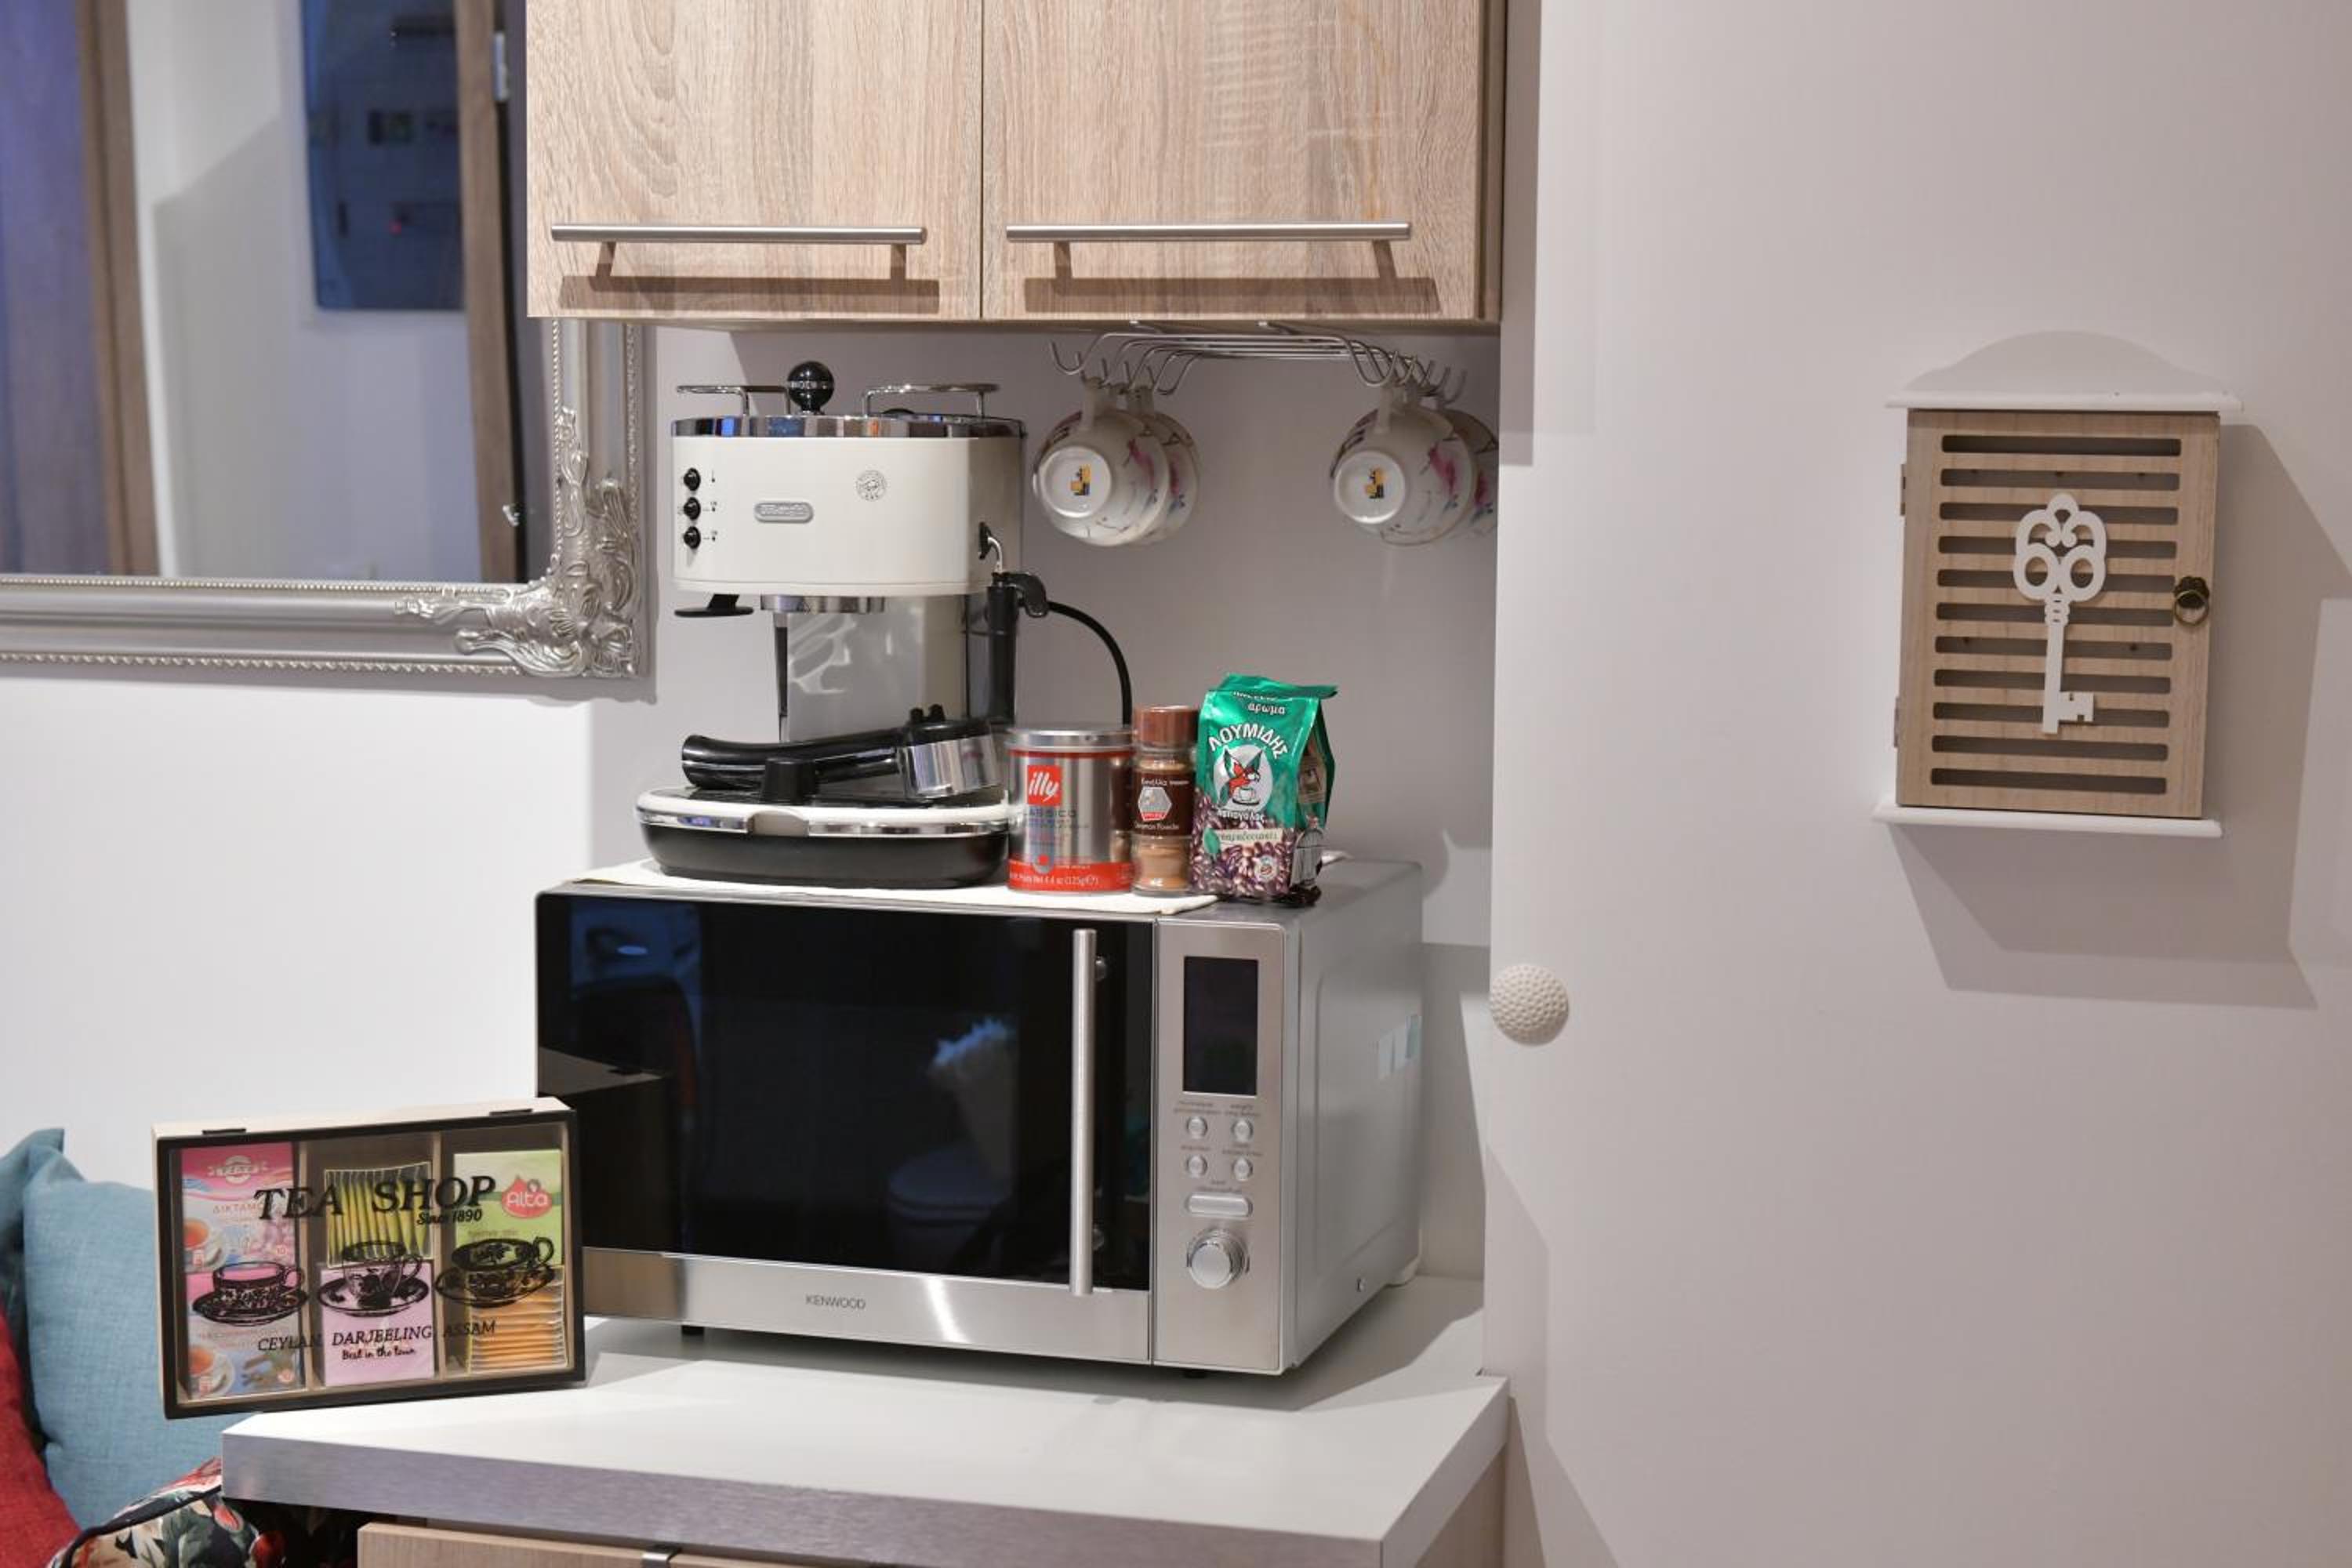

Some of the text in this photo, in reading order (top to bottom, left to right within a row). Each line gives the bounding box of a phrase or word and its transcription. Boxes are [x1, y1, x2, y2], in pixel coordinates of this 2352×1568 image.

[1208, 723, 1288, 760] ΛΟΥΜΙΔΗΣ
[1029, 771, 1059, 802] illy
[253, 1175, 497, 1221] TEA SHOP
[452, 1209, 483, 1223] 1890
[805, 1294, 866, 1309] KENWOOD
[332, 1325, 433, 1346] DARJEELING
[443, 1320, 496, 1338] ASSAM
[342, 1348, 363, 1360] Best
[365, 1348, 375, 1359] in
[376, 1345, 393, 1357] the
